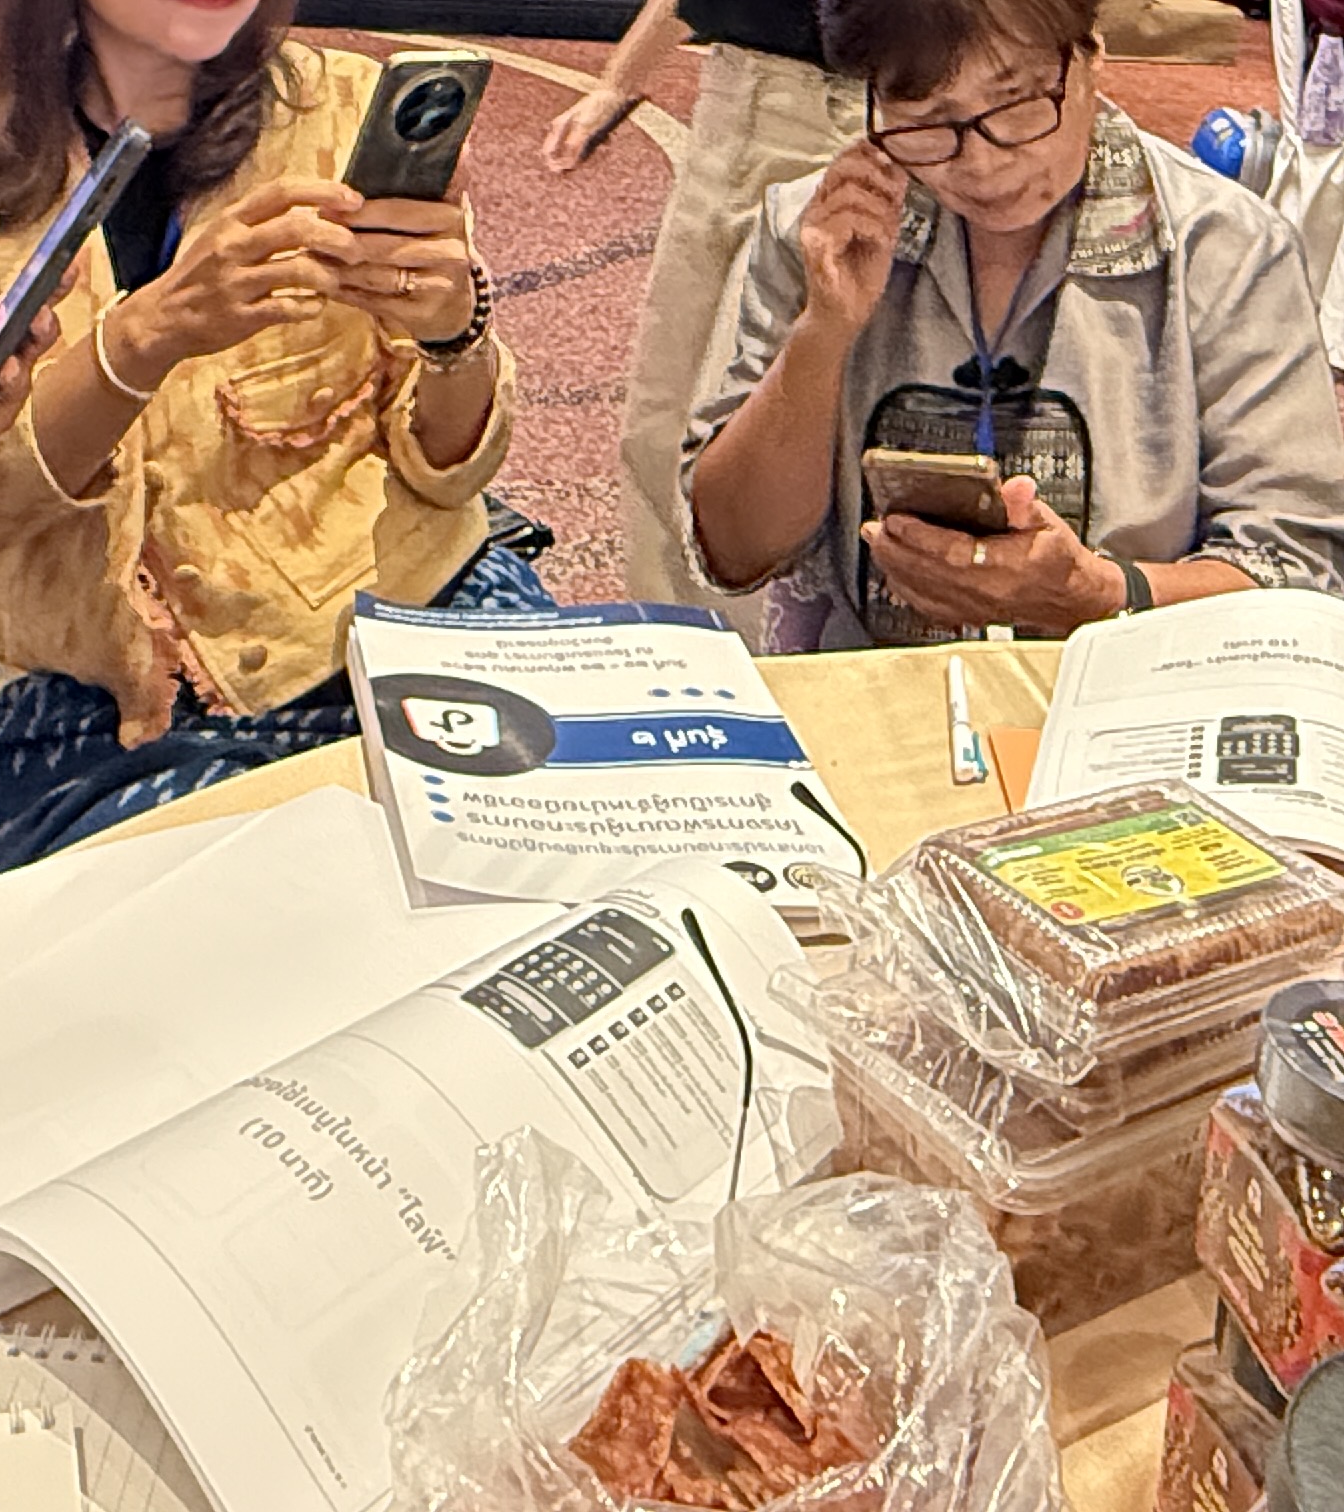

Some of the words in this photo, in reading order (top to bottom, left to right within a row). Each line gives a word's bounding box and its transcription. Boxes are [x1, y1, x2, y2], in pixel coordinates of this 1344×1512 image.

[466, 811, 805, 838] โครงการพัฒนาผู้ประกอบการ
[239, 1116, 286, 1149] (10
[279, 1147, 334, 1202] นาที)
